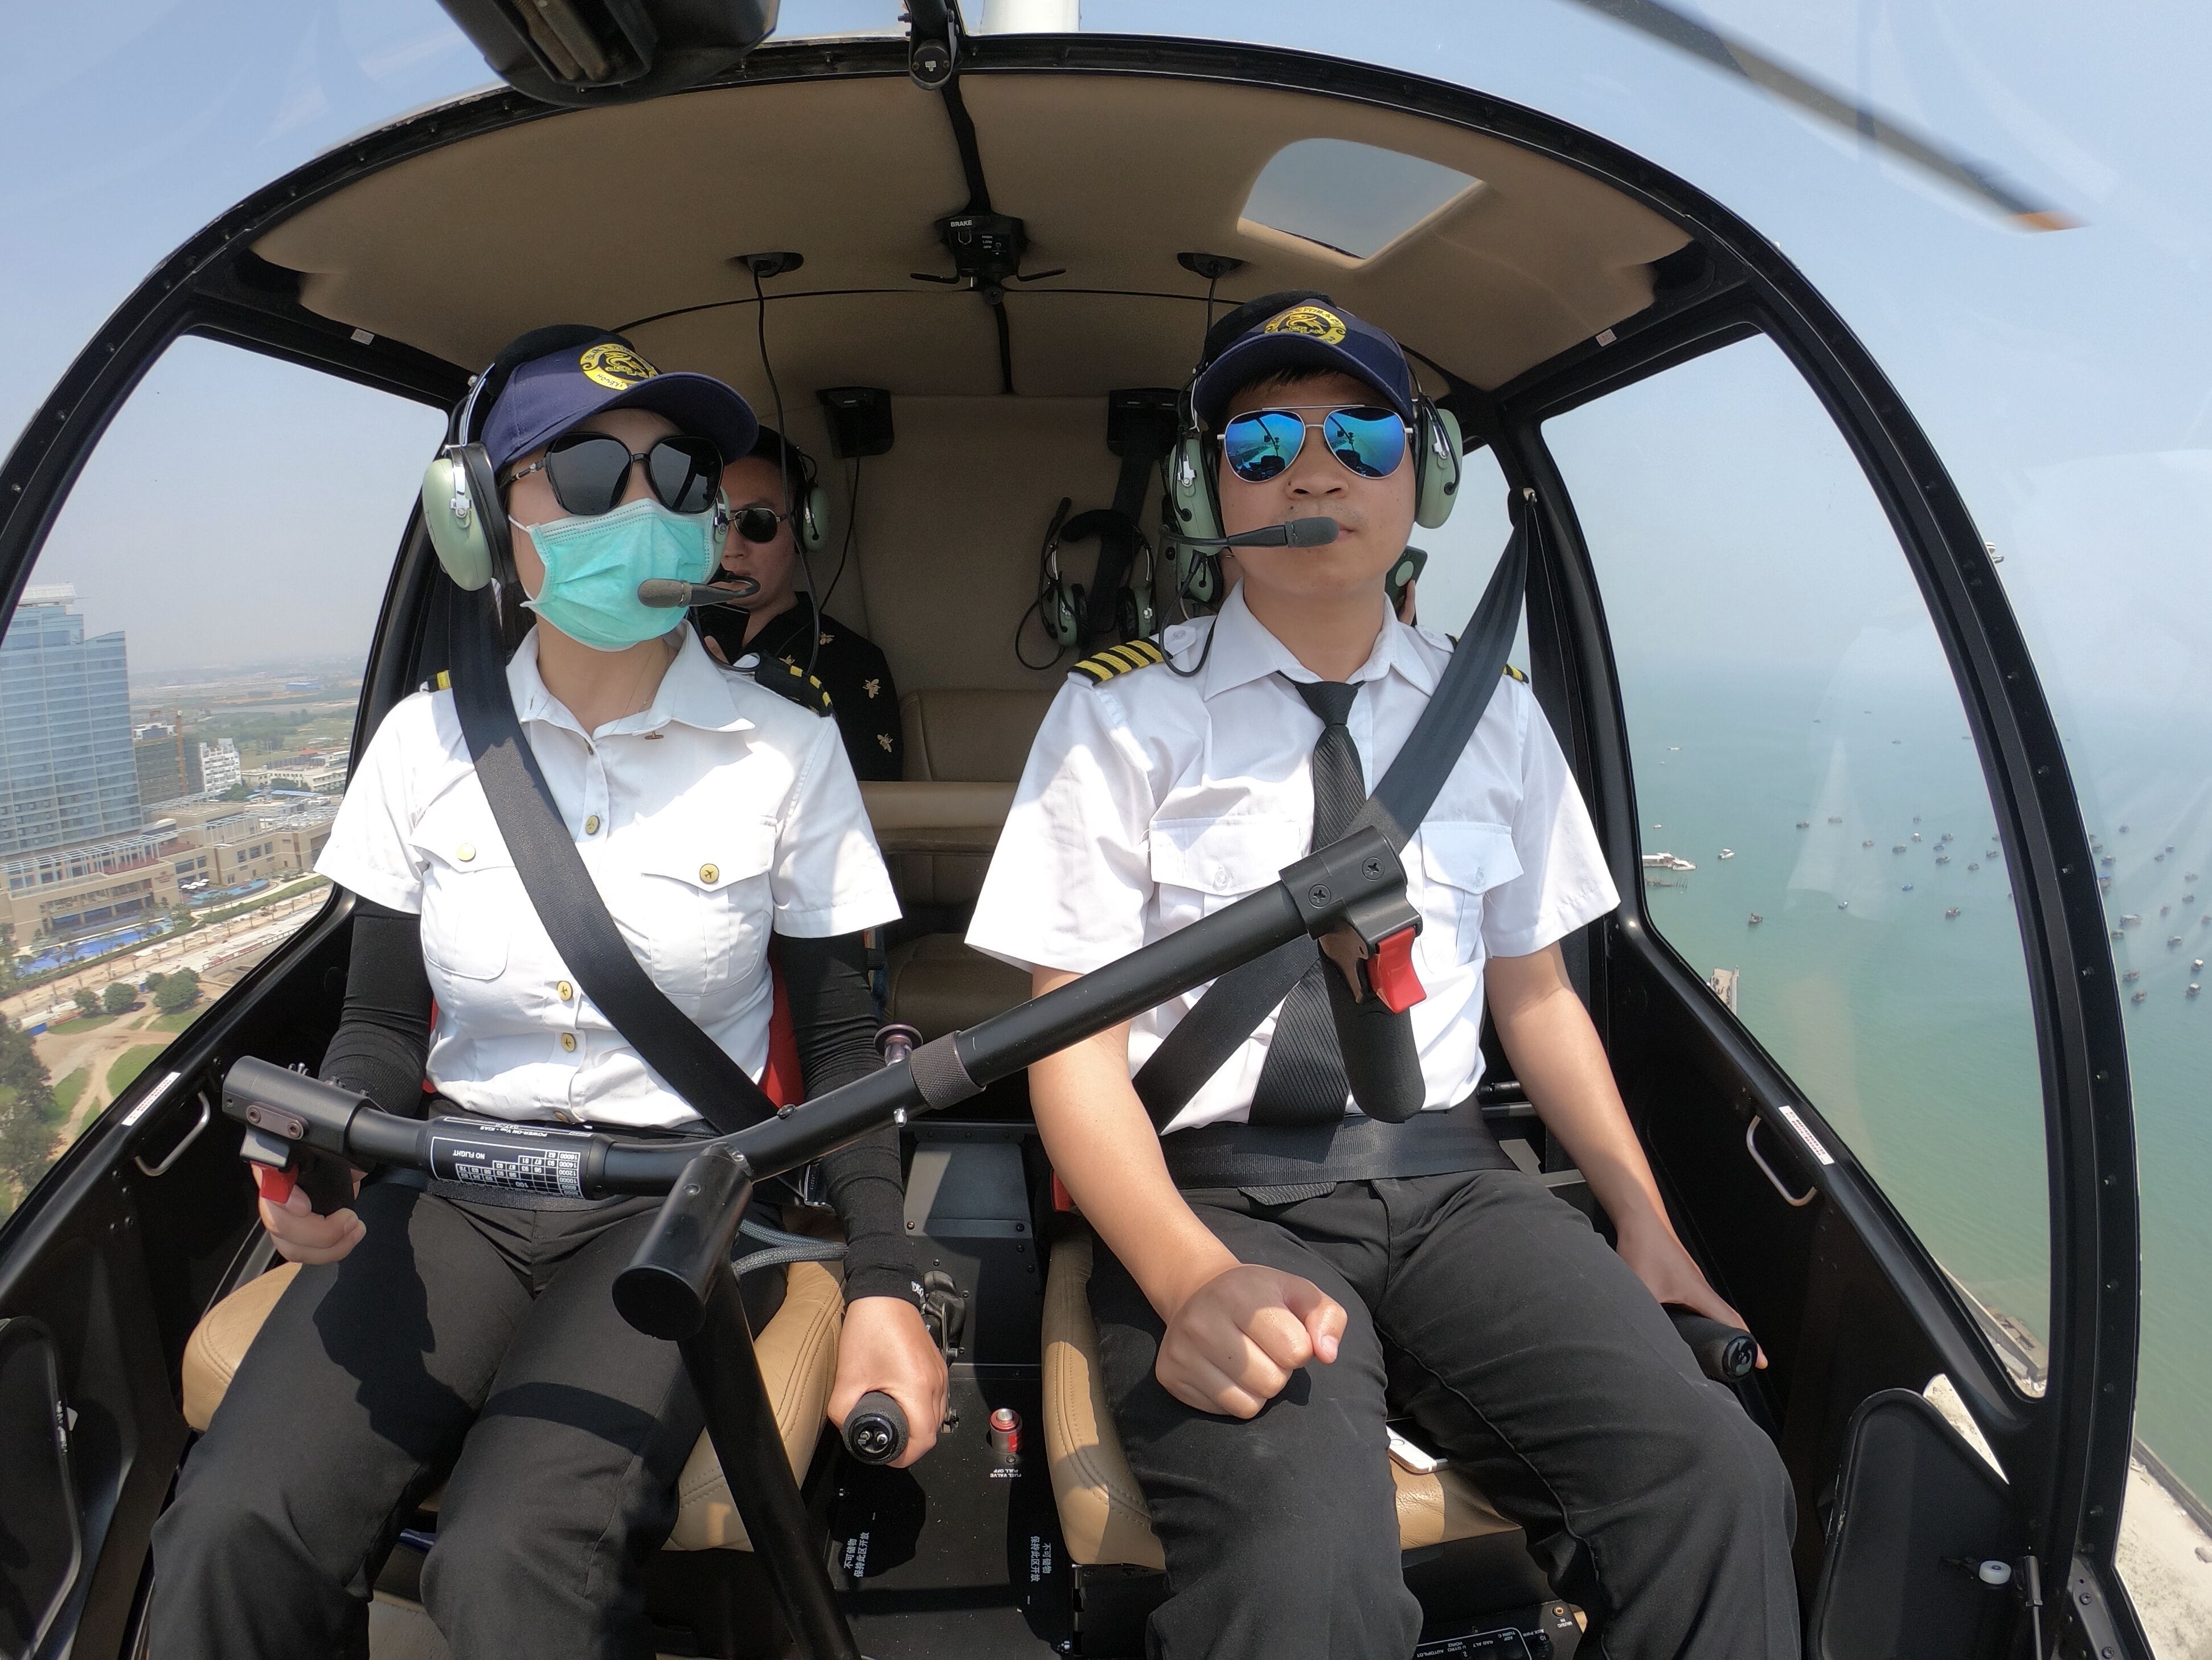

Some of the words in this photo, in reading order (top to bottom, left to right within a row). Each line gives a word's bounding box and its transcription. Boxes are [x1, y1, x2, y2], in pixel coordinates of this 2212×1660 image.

[596, 373, 624, 387] Hongyi
[453, 1150, 474, 1158] FLIGHT
[854, 1532, 870, 1577] 保持此区开放
[1030, 1536, 1041, 1582] 保持此区开放
[1416, 1649, 1444, 1658] AUTOPILOT
